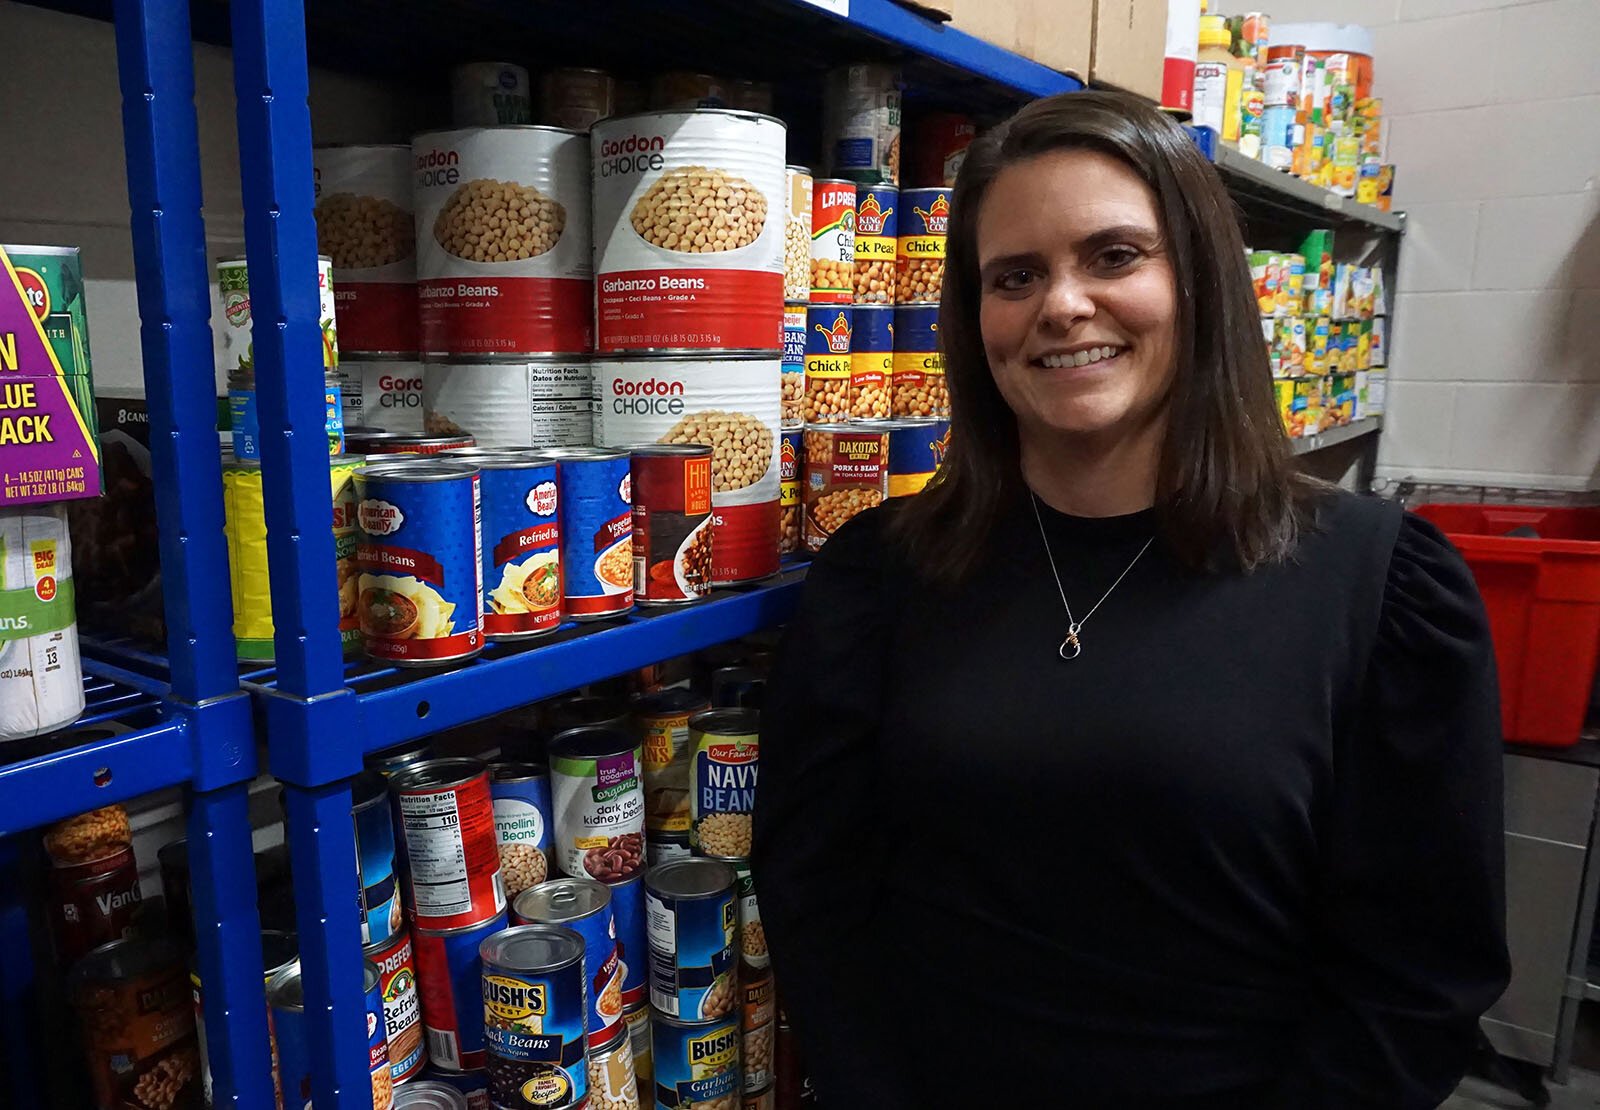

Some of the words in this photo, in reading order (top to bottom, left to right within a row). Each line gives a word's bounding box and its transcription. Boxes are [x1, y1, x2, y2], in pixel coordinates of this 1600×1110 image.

[601, 134, 664, 157] Gordon
[601, 153, 664, 178] CHOICE
[416, 167, 460, 190] HOICE
[822, 192, 835, 209] LA
[858, 215, 881, 225] KING
[858, 224, 881, 233] COLE
[874, 243, 894, 255] Peas
[906, 241, 941, 252] Chick
[457, 284, 499, 298] Beans
[602, 278, 656, 293] Garbanzo
[659, 276, 705, 290] Beans
[642, 294, 662, 302] Beans
[667, 294, 689, 302] Grade
[689, 294, 696, 302] A
[712, 334, 722, 345] kg
[808, 360, 841, 372] Chick
[854, 375, 864, 383] Low
[612, 377, 685, 396] Gordon
[533, 404, 555, 412] Calories
[612, 398, 685, 416] CHOICE
[117, 408, 128, 425] 8
[66, 466, 85, 480] CANS
[833, 464, 854, 472] PORK
[860, 463, 880, 473] BEANS
[690, 463, 708, 490] HH
[5, 485, 19, 499] NET
[19, 484, 31, 497] WT
[519, 530, 551, 547] Refried
[34, 550, 54, 563] BIG
[381, 550, 415, 568] Beans
[43, 579, 50, 589] 4
[46, 652, 58, 665] 13
[711, 748, 727, 758] Our
[600, 768, 634, 783] goodness
[708, 764, 759, 789] NAVY
[597, 777, 637, 802] organic
[433, 792, 456, 802] Facts
[703, 788, 755, 811] BEAN
[596, 804, 622, 815] dark
[623, 797, 637, 810] red
[441, 814, 458, 826] 110
[583, 812, 620, 827] kidney
[622, 803, 643, 819] beans
[502, 829, 536, 842] Beans
[483, 984, 543, 1010] BUSH'S
[493, 1004, 522, 1016] BEST
[508, 1035, 550, 1049] Beans
[692, 1034, 734, 1061] BUSH
[531, 1085, 562, 1101] Recipes
[534, 1082, 558, 1092] FAVORITE
